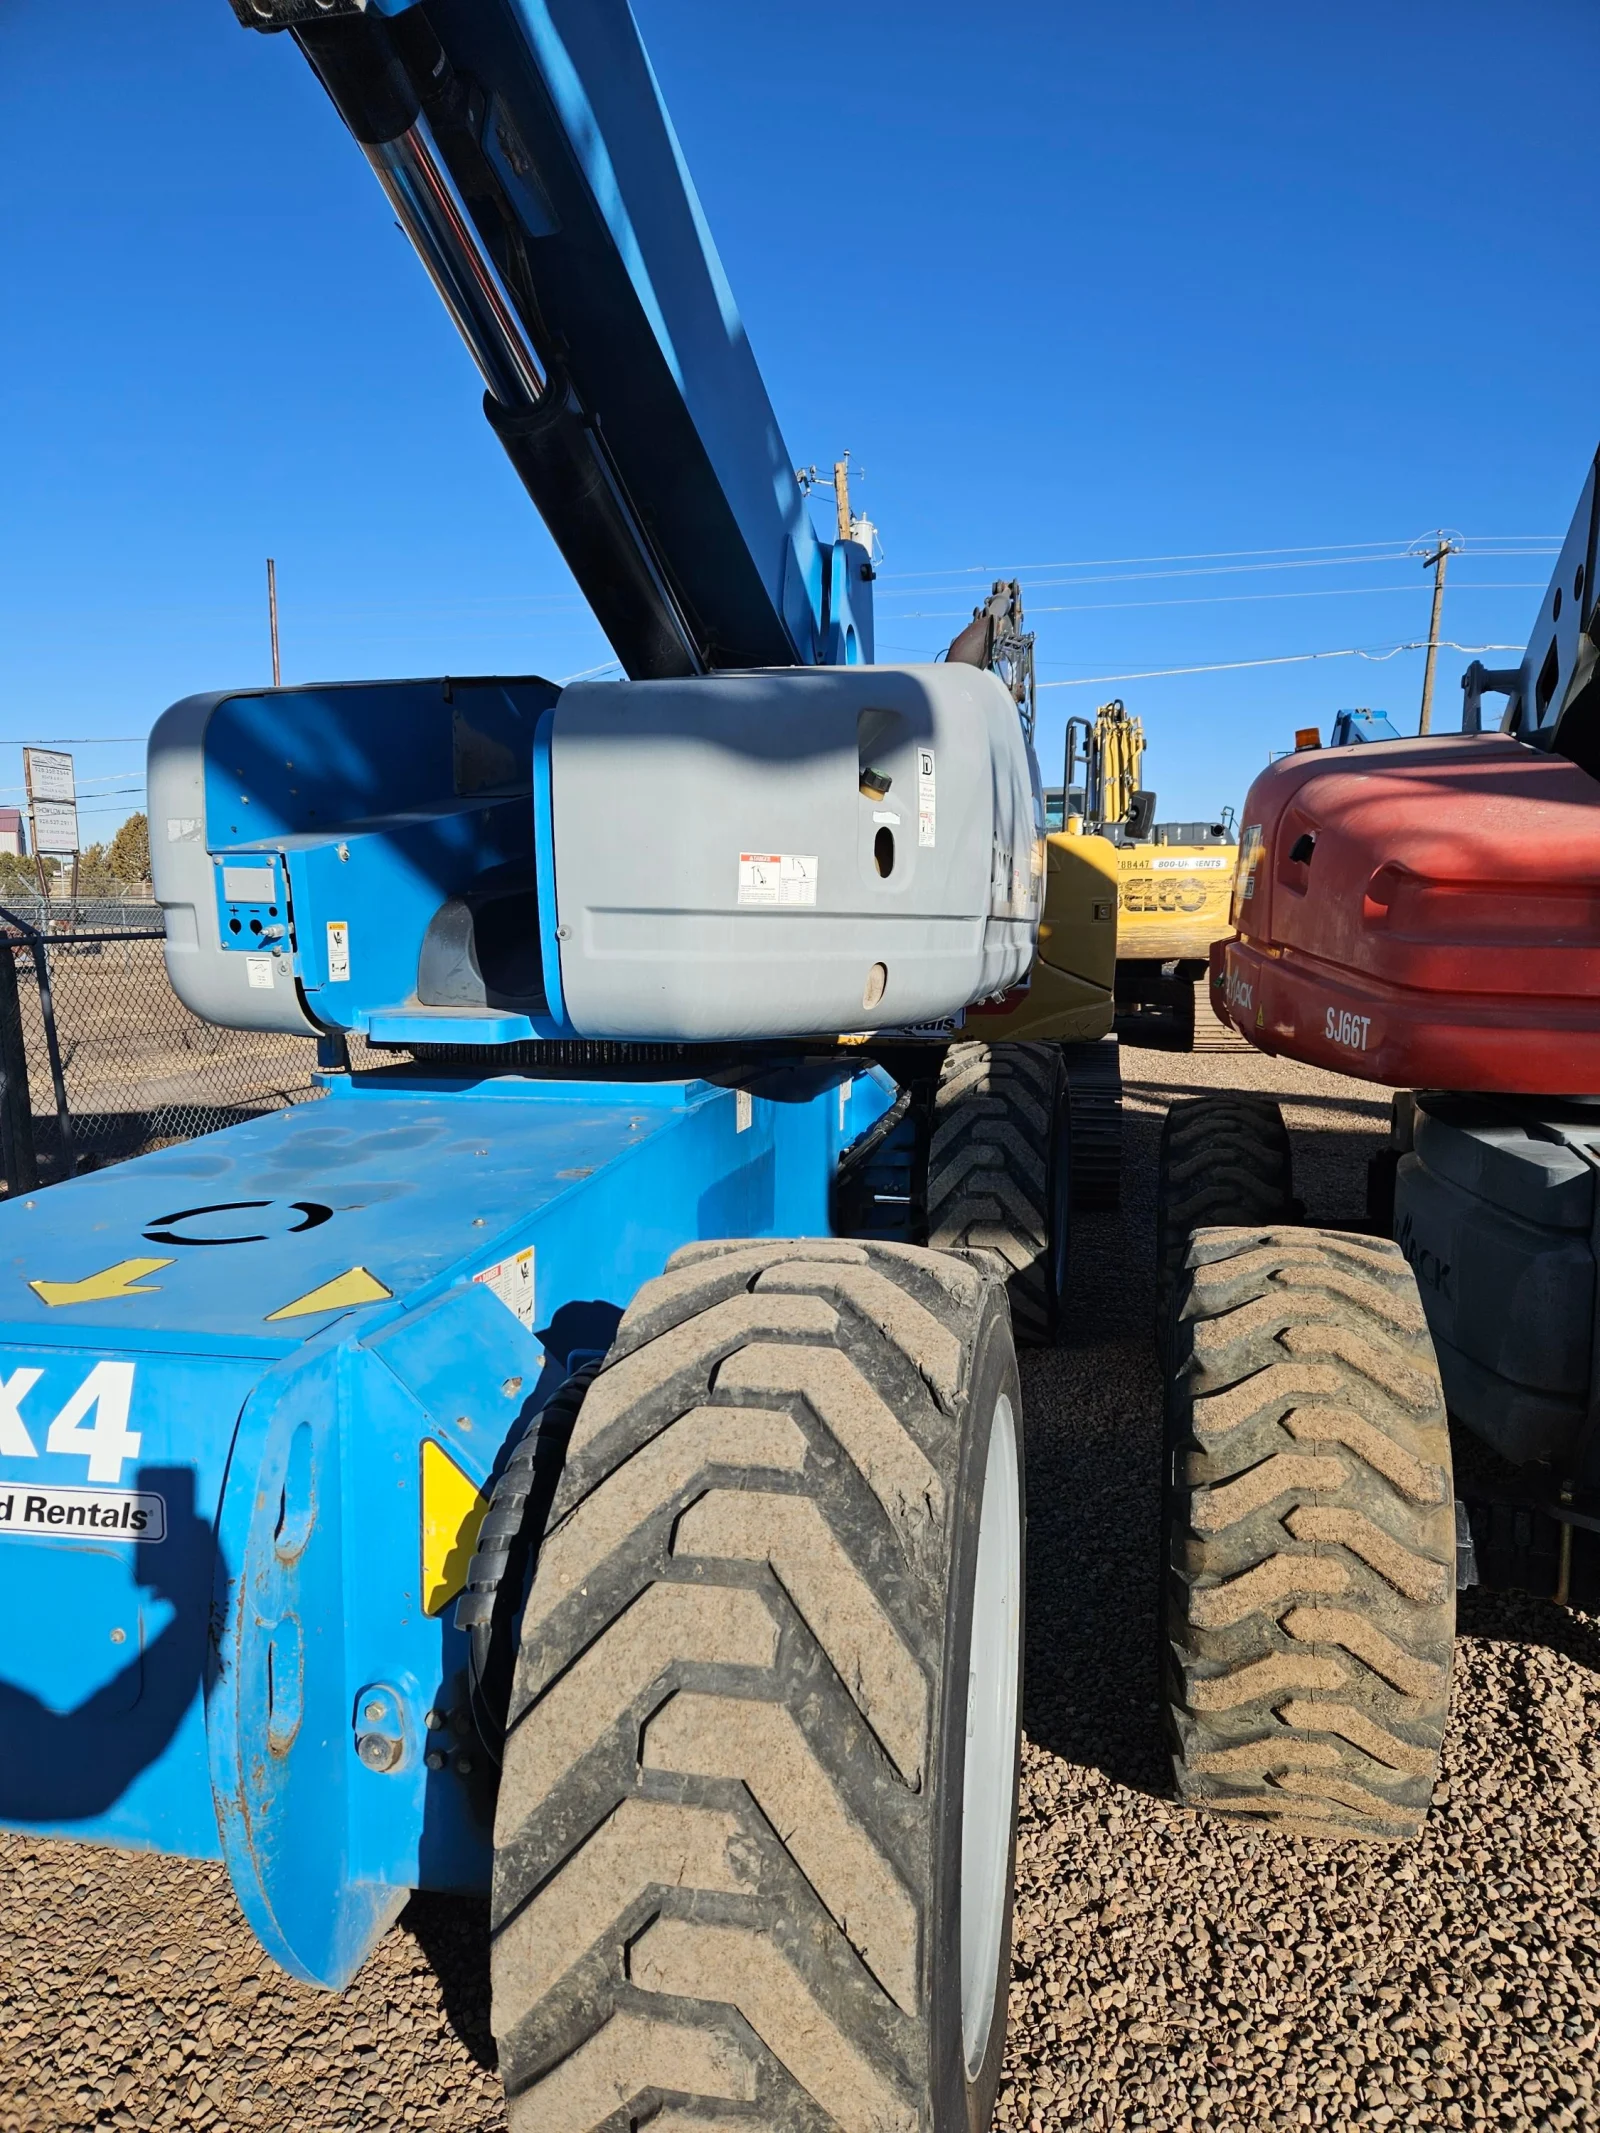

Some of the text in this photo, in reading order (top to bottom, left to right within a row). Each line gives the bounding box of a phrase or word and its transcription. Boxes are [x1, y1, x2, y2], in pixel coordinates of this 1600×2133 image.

[1117, 859, 1150, 869] 88447
[1325, 1006, 1371, 1051] SJ66T
[23, 1495, 149, 1531] Rentals
